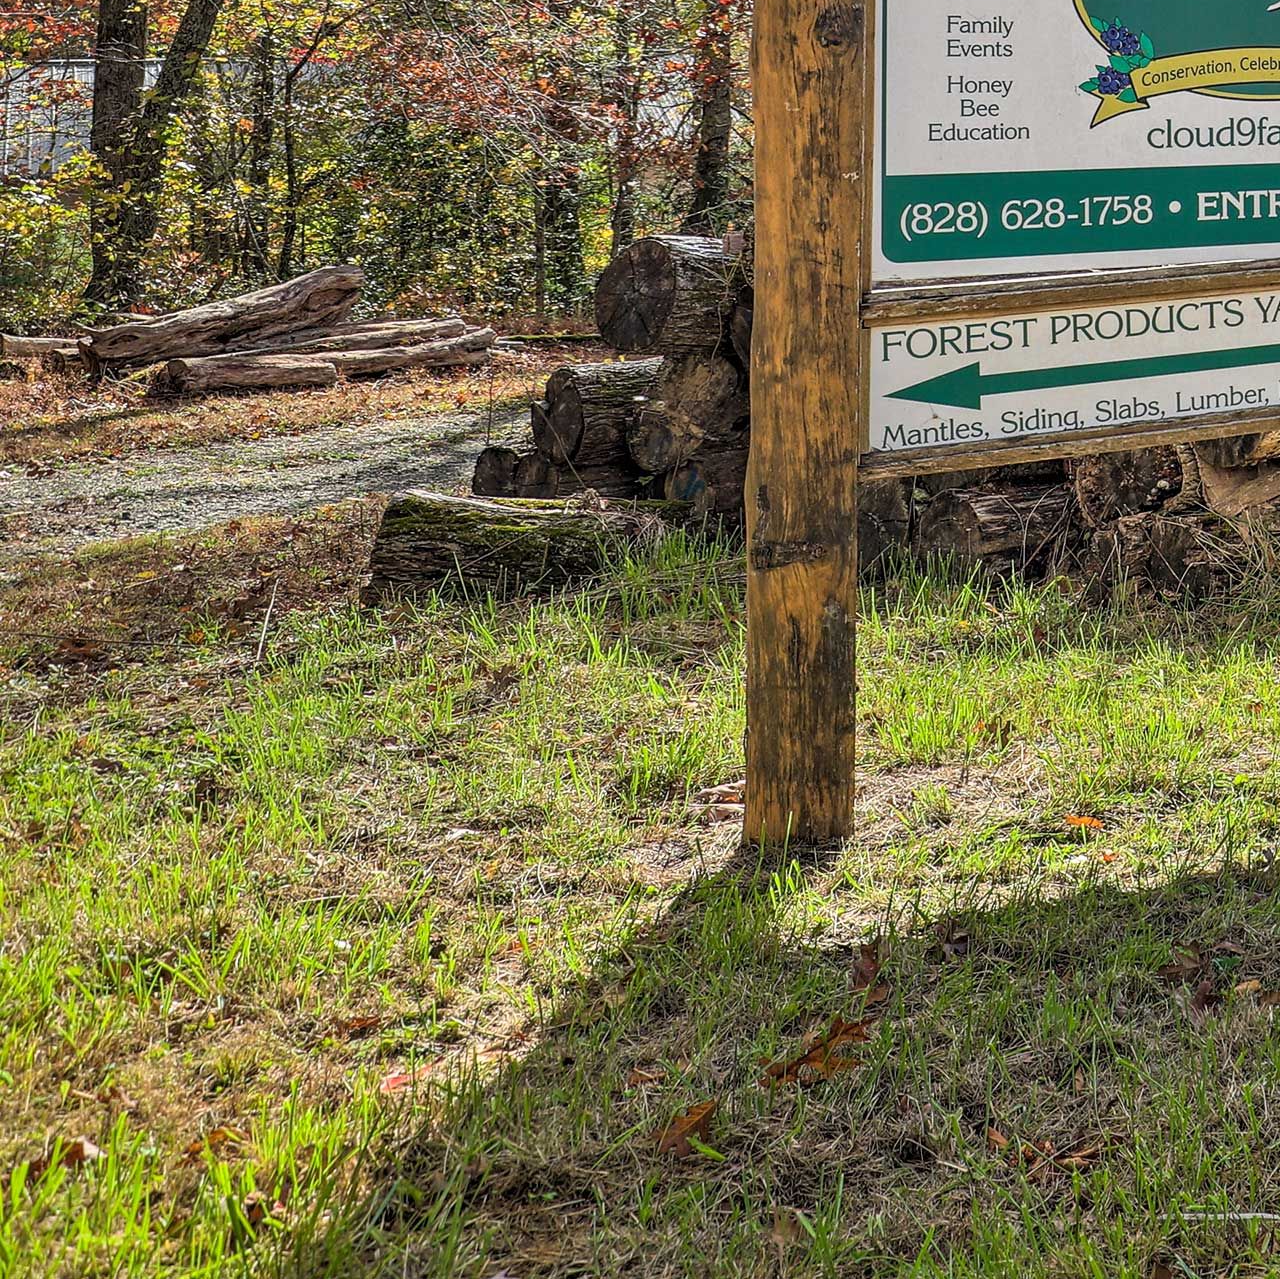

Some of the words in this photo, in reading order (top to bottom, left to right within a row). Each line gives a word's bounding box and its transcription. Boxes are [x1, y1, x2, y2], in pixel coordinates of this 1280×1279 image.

[947, 16, 1014, 38] Family
[946, 39, 1013, 57] Events
[1141, 61, 1236, 87] Conservation,
[947, 76, 1013, 97] Honey
[960, 99, 999, 117] Bee
[928, 123, 1030, 141] Education
[900, 201, 989, 241] (828)
[1001, 194, 1153, 230] 628-1758
[881, 318, 1038, 361] FOREST
[1050, 299, 1244, 344] PRODUCTS
[881, 418, 991, 449] Mantles,
[1001, 409, 1085, 434] Siding,
[1095, 397, 1165, 422] Slabs,
[1175, 384, 1270, 414] Lumber,
